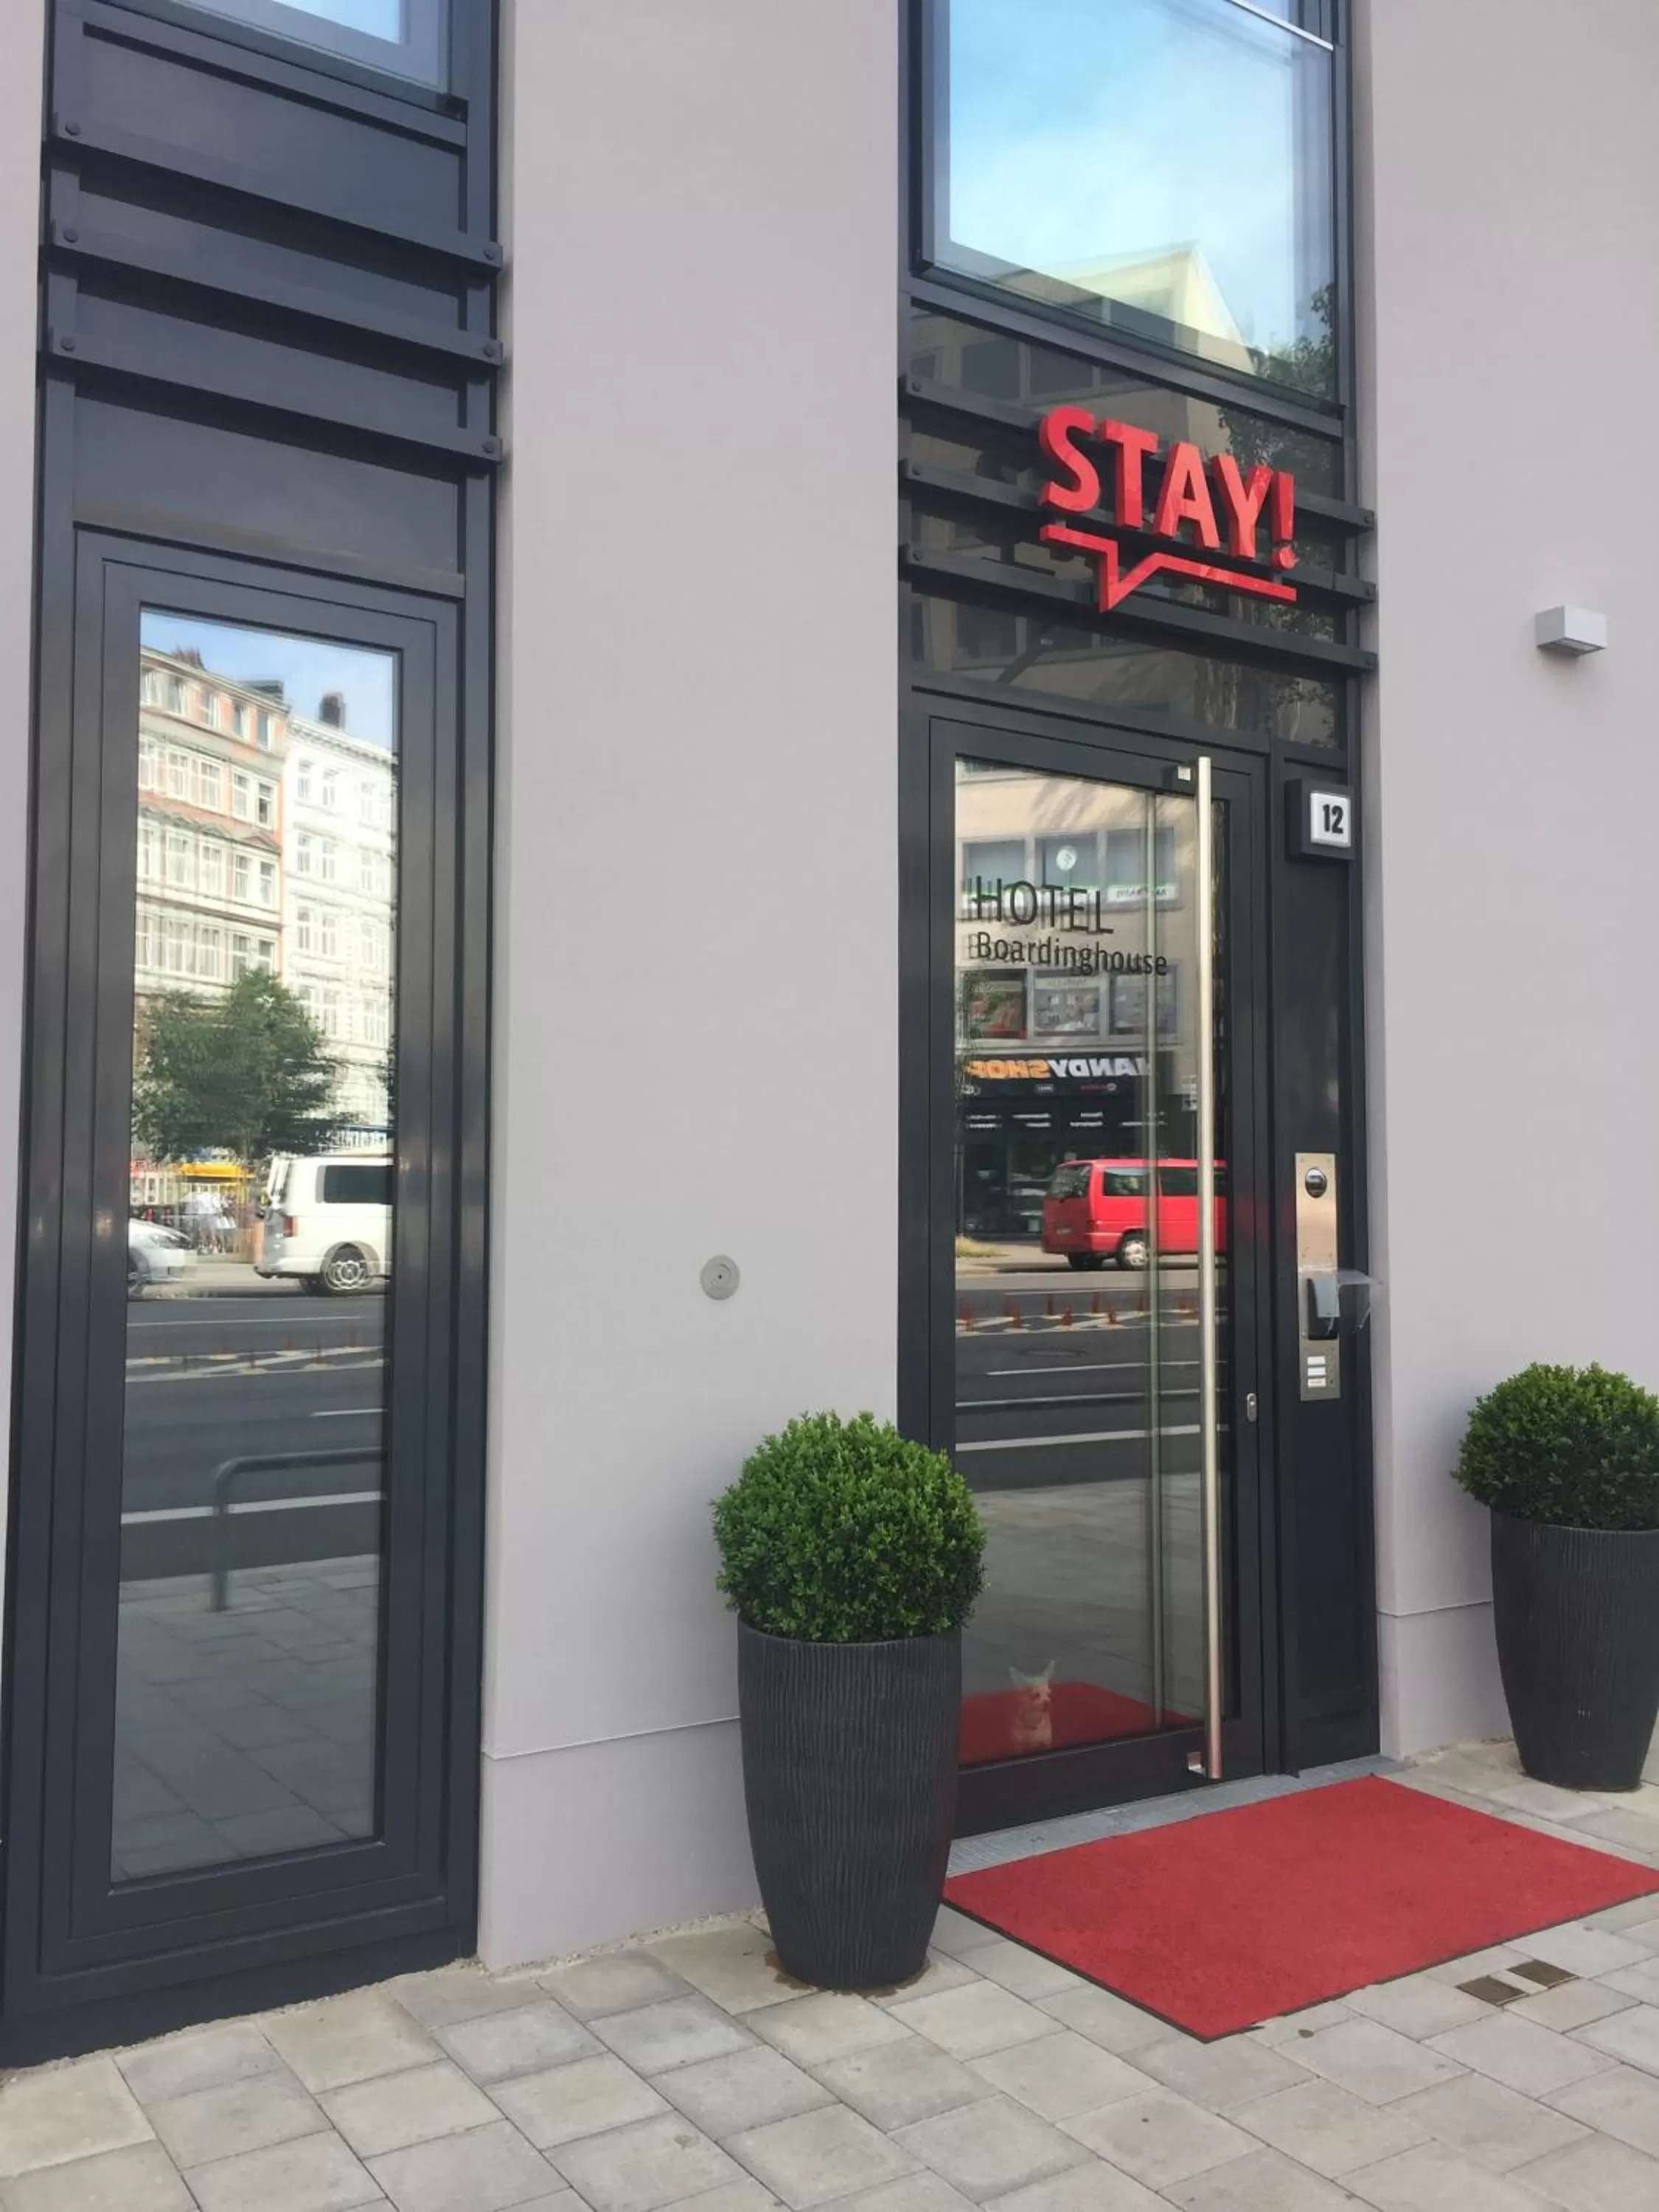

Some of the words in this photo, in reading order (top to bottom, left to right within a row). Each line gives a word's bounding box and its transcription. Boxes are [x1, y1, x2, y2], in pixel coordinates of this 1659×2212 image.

[1039, 406, 1298, 571] STAY!
[1322, 804, 1343, 834] 12
[975, 875, 1114, 934] HOTEL
[976, 931, 1168, 975] Boardinghouse
